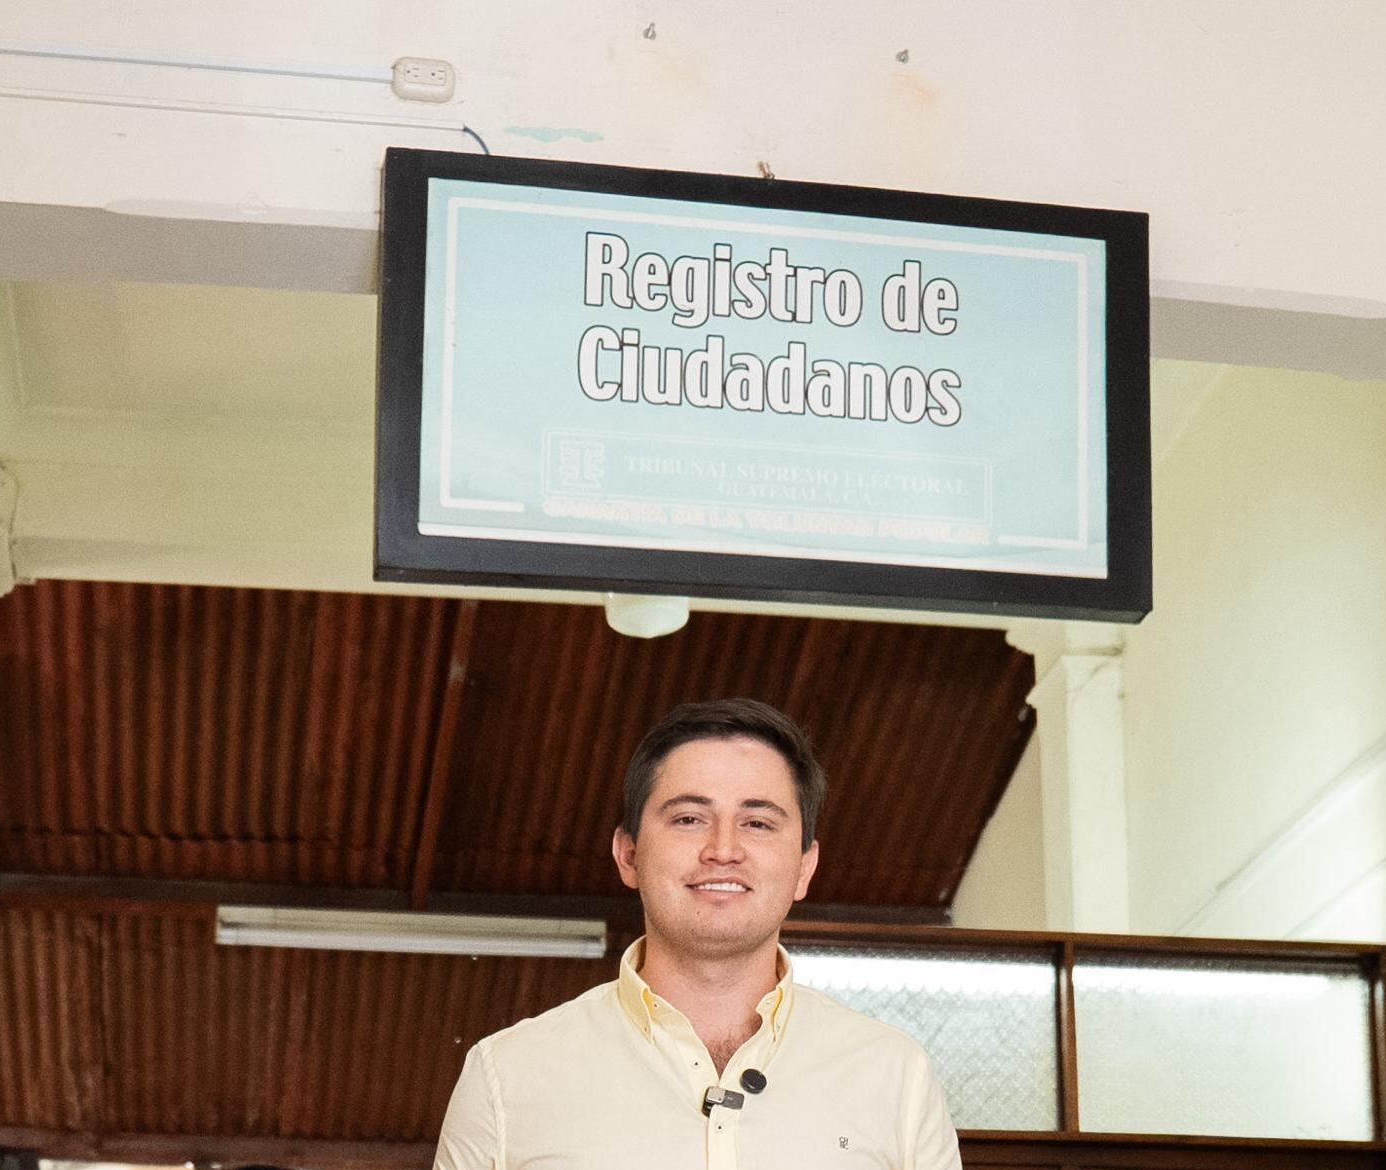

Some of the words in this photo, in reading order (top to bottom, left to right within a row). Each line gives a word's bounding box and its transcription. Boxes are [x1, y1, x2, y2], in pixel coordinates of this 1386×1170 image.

[583, 230, 864, 327] Registro
[881, 260, 960, 336] de
[576, 324, 962, 428] Ciudadanos
[624, 453, 728, 479] TRIBUNAL
[734, 462, 839, 487] SUPREMO
[843, 469, 970, 497] ELECTORAL
